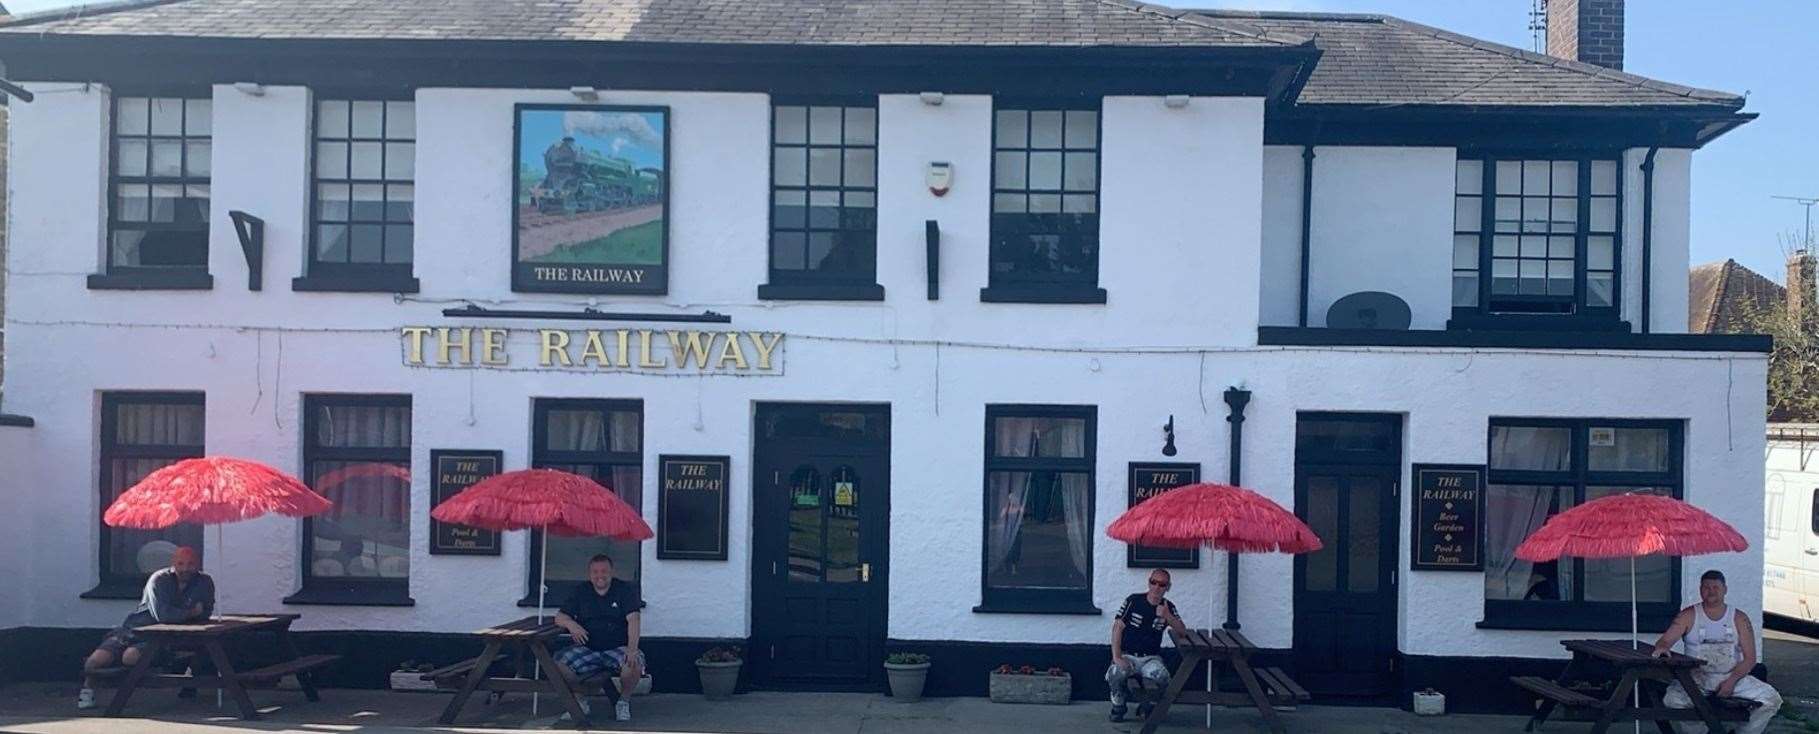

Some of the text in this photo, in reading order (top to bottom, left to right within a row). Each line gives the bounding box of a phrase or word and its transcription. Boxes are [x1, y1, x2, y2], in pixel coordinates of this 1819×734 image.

[534, 267, 644, 283] THE RAILWAY
[402, 327, 784, 369] THE RAILWAY
[456, 461, 480, 472] THE
[681, 464, 707, 476] THE
[1152, 473, 1178, 484] THE
[1438, 477, 1462, 487] THE
[665, 479, 721, 490] RAILWAY
[1423, 489, 1476, 500] RAILWAY
[1439, 512, 1460, 521] Beer
[1433, 522, 1465, 532] Garden
[1433, 543, 1463, 553] Pool &
[1437, 554, 1460, 563] Darts
